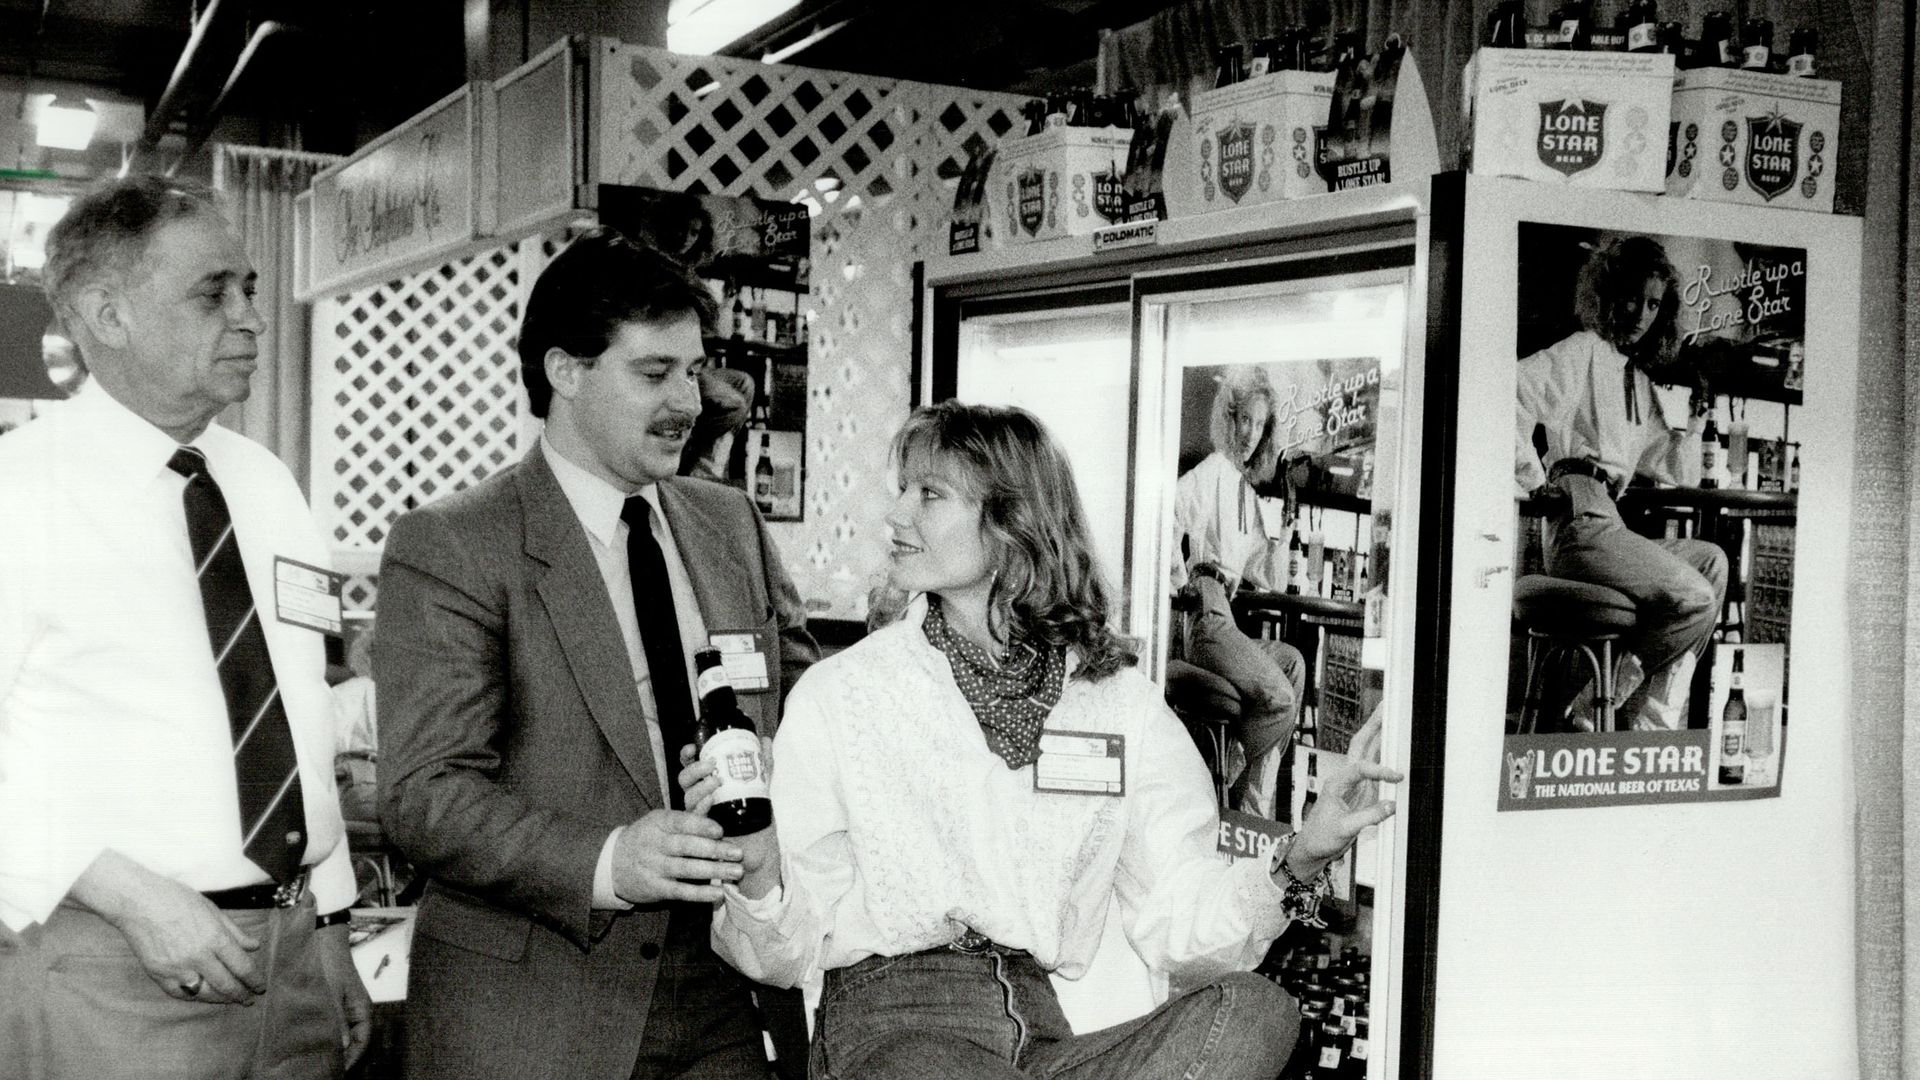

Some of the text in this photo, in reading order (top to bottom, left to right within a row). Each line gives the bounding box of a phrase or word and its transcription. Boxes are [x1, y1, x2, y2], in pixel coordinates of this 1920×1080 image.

[1545, 114, 1600, 132] LONE
[1222, 139, 1250, 157] LONE
[1543, 134, 1598, 152] STAR
[1754, 134, 1793, 153] LONE
[1222, 158, 1250, 176] STAR
[1337, 158, 1381, 177] RUSTLE UP
[1752, 154, 1791, 172] STAR
[1098, 183, 1122, 194] LON
[1097, 195, 1122, 206] STA
[779, 212, 797, 229] up
[764, 222, 797, 247] Star
[1102, 226, 1154, 243] COLDMATIC
[1683, 259, 1804, 306] Rustle up a
[1683, 285, 1791, 346] Lone Star
[1279, 368, 1379, 424] Rustle up a
[1279, 398, 1366, 461] Lone Star
[1535, 747, 1617, 778] LONE
[1623, 745, 1703, 775] STAR
[1535, 778, 1700, 797] THE NATIONAL BEER OF TEXAS
[1234, 826, 1272, 858] STA
